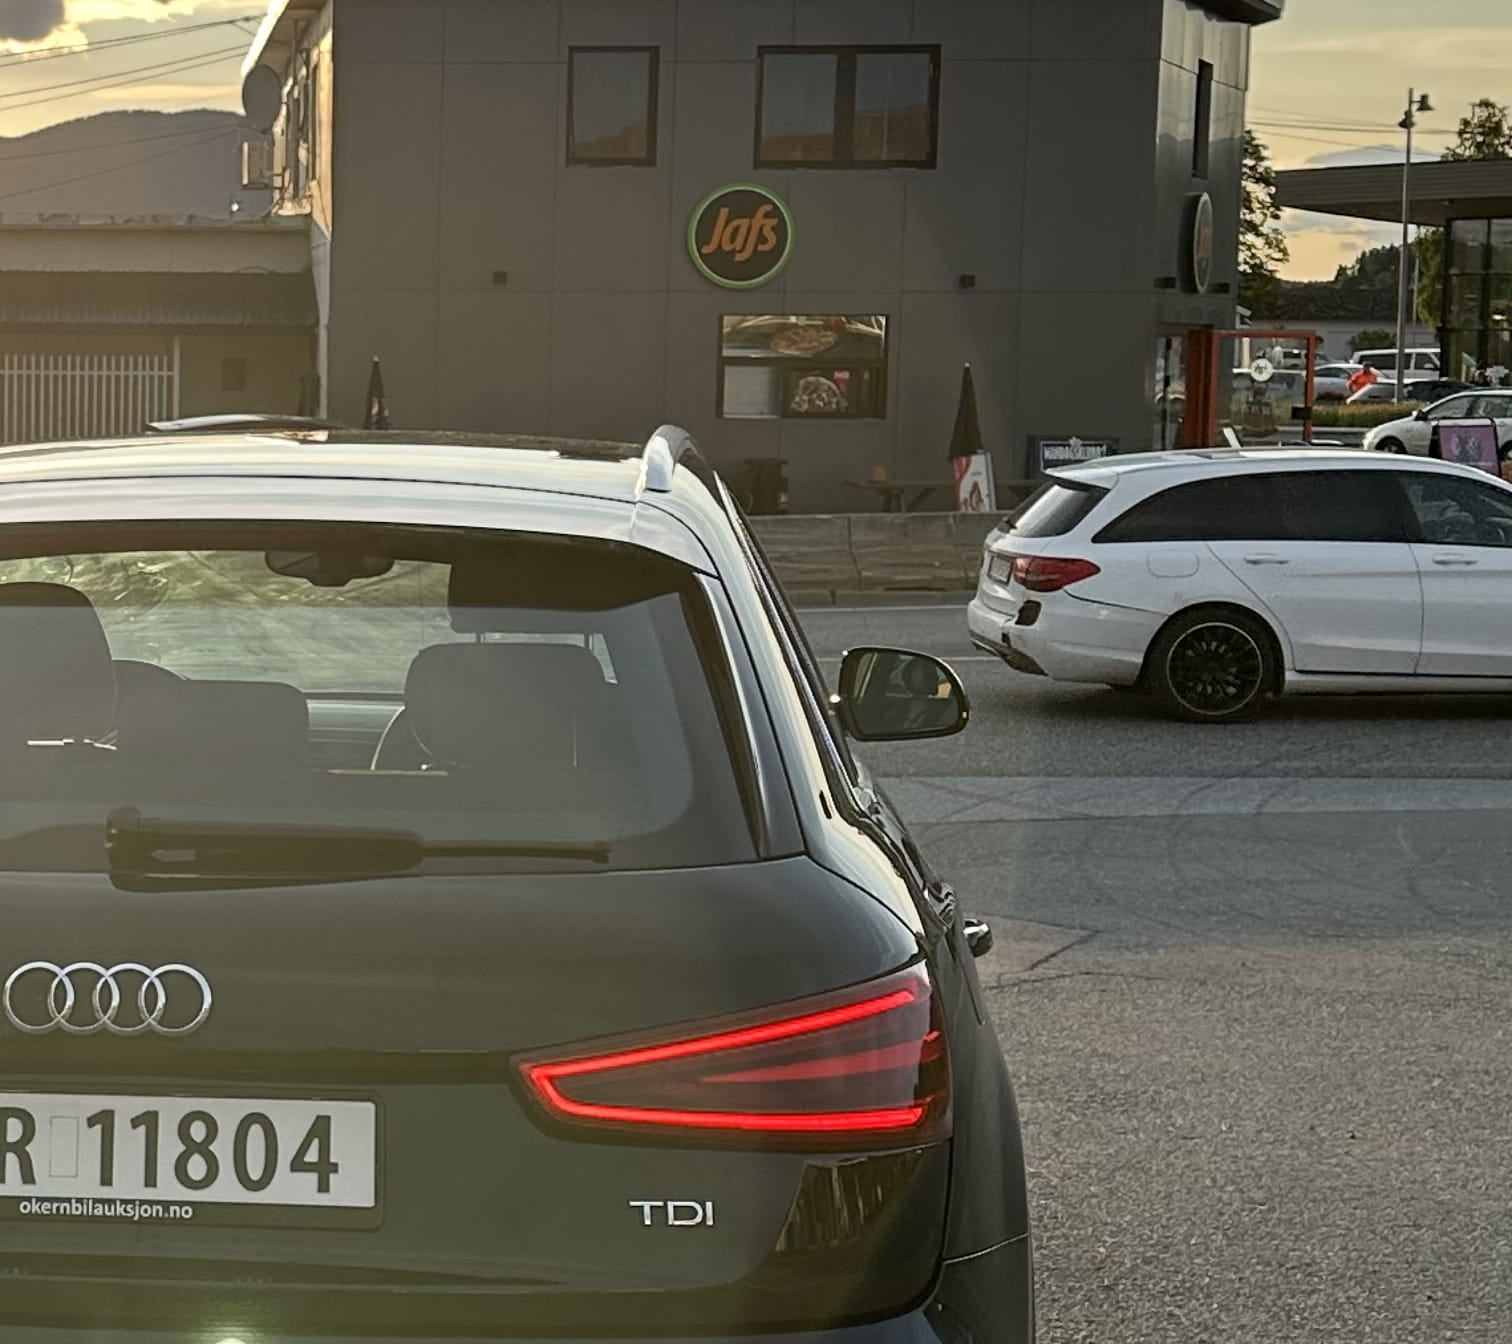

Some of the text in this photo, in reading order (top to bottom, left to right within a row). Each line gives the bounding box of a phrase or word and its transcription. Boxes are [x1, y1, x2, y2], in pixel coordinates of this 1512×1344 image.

[701, 204, 778, 261] Jafs
[86, 1109, 339, 1193] 11804
[19, 1198, 193, 1221] okernbilauksjon.no
[629, 1201, 714, 1225] TDI
